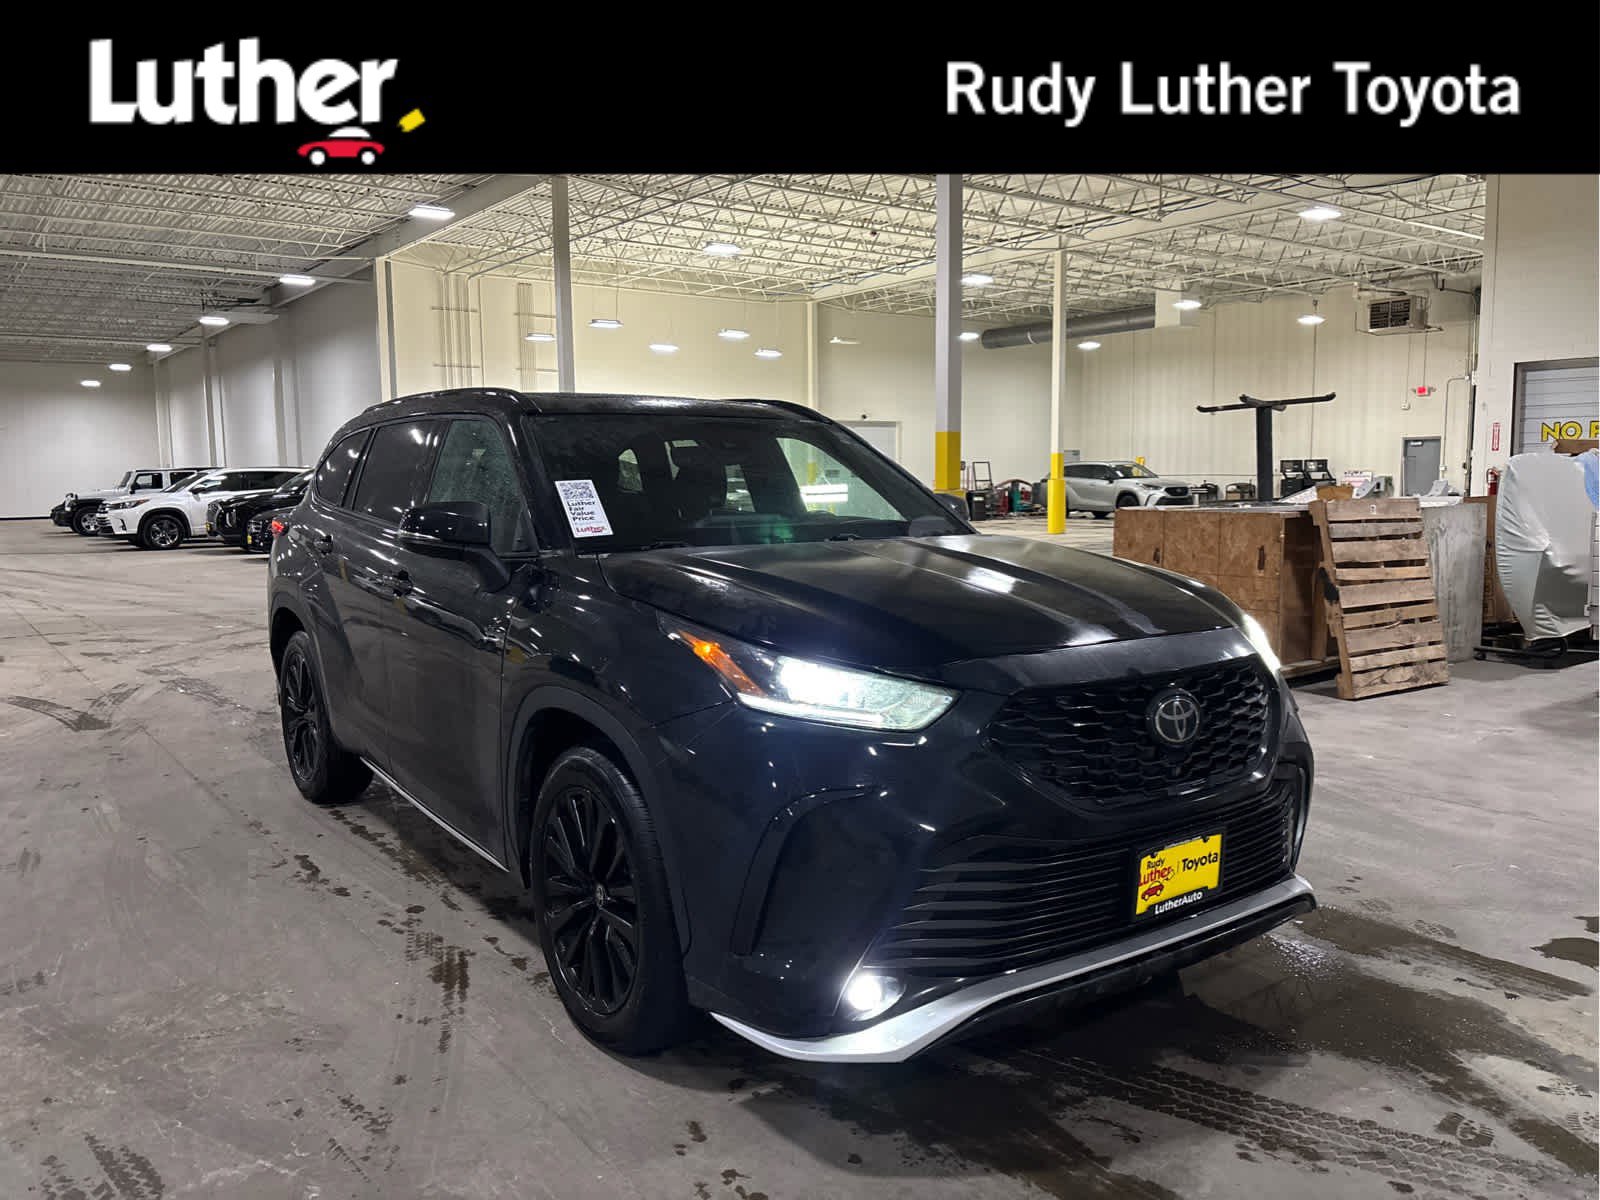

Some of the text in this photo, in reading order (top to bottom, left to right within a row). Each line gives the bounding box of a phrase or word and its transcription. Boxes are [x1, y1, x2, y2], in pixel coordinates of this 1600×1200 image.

[1541, 421, 1582, 442] NO
[1146, 857, 1166, 870] Rudy
[1182, 852, 1219, 873] Toyota
[1138, 865, 1174, 887] Luther
[1154, 891, 1204, 915] LutherAuto
